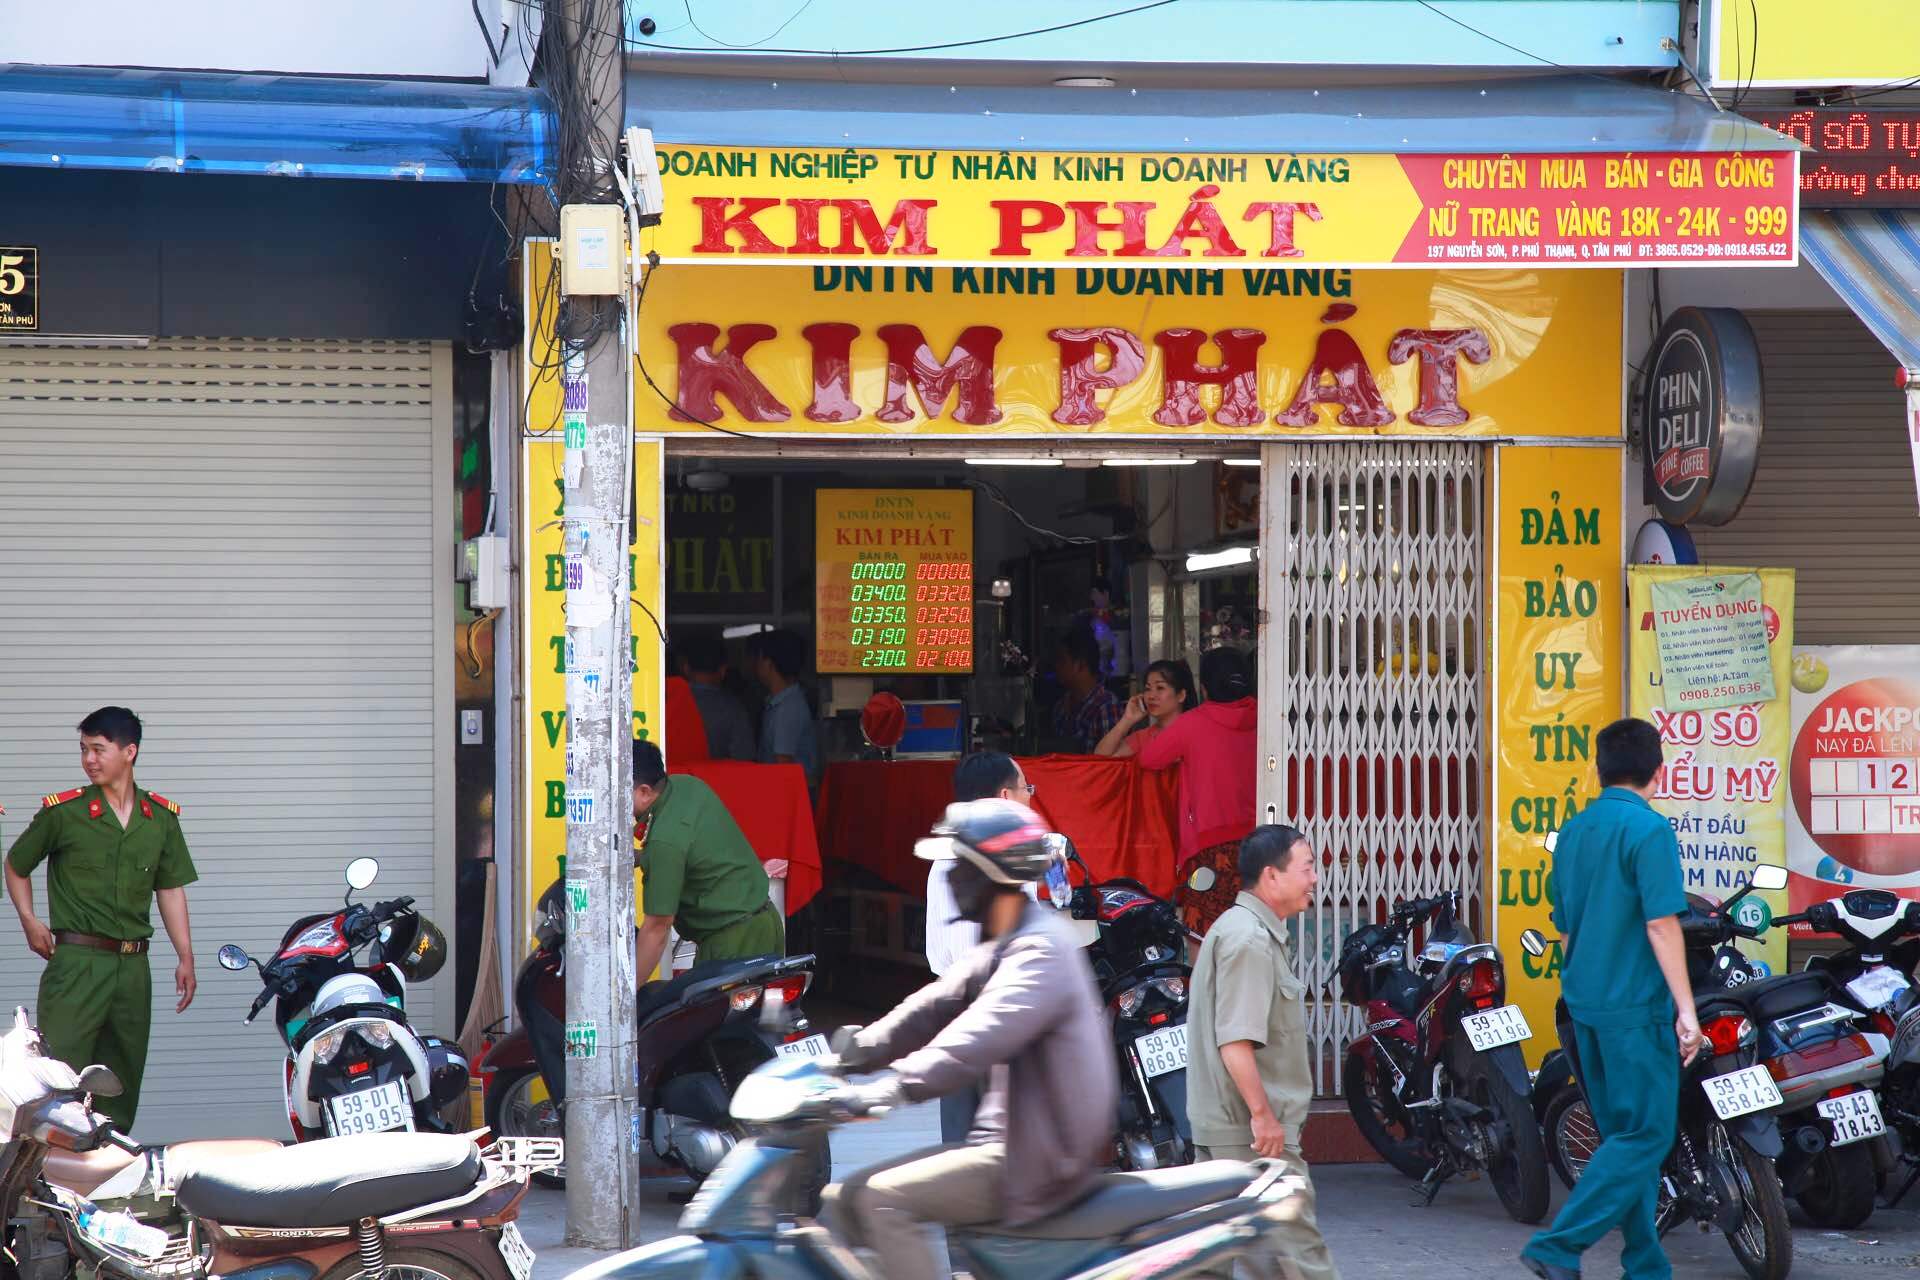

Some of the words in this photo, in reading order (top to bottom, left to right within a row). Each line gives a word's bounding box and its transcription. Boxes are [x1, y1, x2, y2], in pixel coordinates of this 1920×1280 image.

[655, 151, 757, 178] DOANH
[771, 148, 878, 183] NGHIỆP
[895, 151, 936, 180] TƯ
[953, 151, 1037, 181] NHÂN
[1054, 156, 1124, 182] KINH
[1141, 157, 1247, 183] DOANH
[1265, 153, 1350, 183] VÀNG
[1442, 154, 1527, 189] CHUYÊN
[1541, 158, 1587, 189] MUA
[1605, 153, 1648, 190] BÁN
[1669, 158, 1704, 188] GIA
[1715, 153, 1775, 189] CÔNG
[691, 196, 938, 256] KIM
[990, 184, 1324, 258] PHÁT
[1428, 201, 1459, 238] NỮ
[1468, 207, 1540, 238] TRANG
[1556, 201, 1612, 238] VÀNG
[1620, 207, 1661, 238] 18K
[1677, 206, 1721, 237] 24K
[1744, 206, 1788, 237] 999
[1428, 245, 1444, 258] 197
[1447, 240, 1483, 258] NGUYỄN
[1614, 241, 1632, 257] PHÚ
[812, 266, 933, 294] DNTN
[952, 267, 1056, 296] KINH
[1076, 268, 1224, 296] DOANH
[667, 321, 1004, 428] KIM
[1048, 302, 1493, 429] PHÁT
[1659, 369, 1702, 410] PHIN
[1658, 411, 1700, 450] DELI
[1661, 452, 1678, 479] FINE
[1679, 452, 1704, 476] COFFEE
[1520, 490, 1600, 546] ĐẢM
[835, 527, 882, 546] KIM
[890, 523, 955, 546] PHÁT
[665, 524, 774, 593] HÁT
[1524, 563, 1598, 618] BẢO
[1660, 600, 1712, 625] TUYỂN
[1715, 599, 1758, 619] DỤNG
[1534, 652, 1582, 690] UY
[1688, 675, 1706, 686] Liên
[1679, 681, 1761, 702] 0908.250.636
[1530, 712, 1590, 763] TÍN
[1816, 737, 1849, 753] NAY
[1660, 751, 1714, 796] IỂU
[1726, 760, 1777, 798] MỸ
[1511, 777, 1598, 834] CHẤ
[1668, 811, 1703, 834] BẮT
[1707, 812, 1746, 836] ĐẦU
[1679, 840, 1699, 861] ÁN
[1705, 840, 1757, 863] HÀNG
[1742, 909, 1760, 923] 16
[1471, 1009, 1514, 1032] 59-T1
[1474, 1021, 1528, 1049] 931.96
[1146, 1047, 1187, 1074] 869.6
[1713, 1070, 1761, 1097] 59-F1
[342, 1087, 390, 1115] 59-D1
[1716, 1086, 1777, 1119] 858.43
[1825, 1095, 1870, 1121] 59-A3
[341, 1105, 402, 1136] 599.95
[271, 1229, 315, 1237] HONDA
